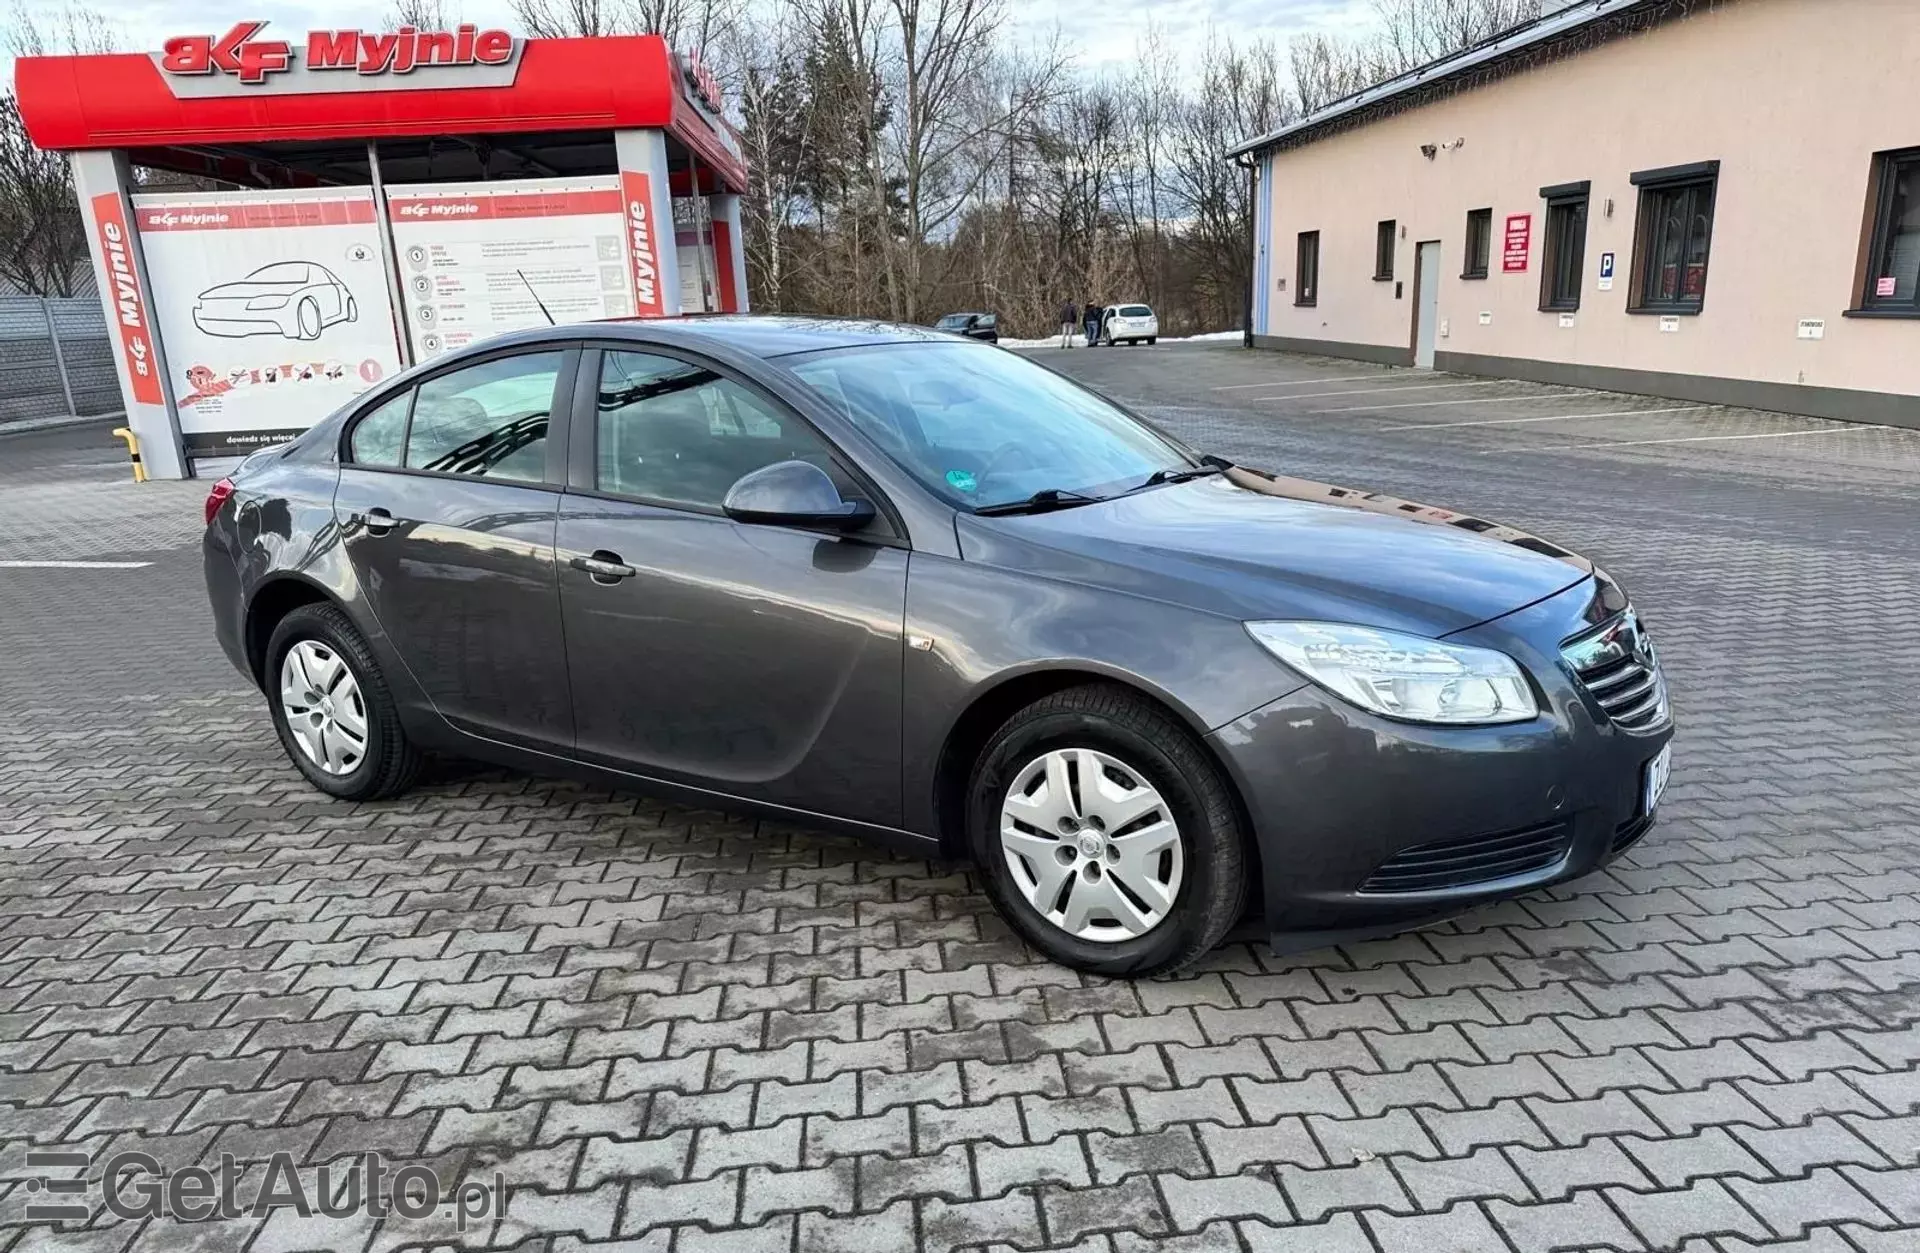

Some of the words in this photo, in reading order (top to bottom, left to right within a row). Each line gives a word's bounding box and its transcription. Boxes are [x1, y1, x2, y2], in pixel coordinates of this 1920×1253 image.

[307, 24, 513, 75] Myjnie
[180, 212, 229, 225] Myjnie
[431, 203, 479, 216] Myjnie
[629, 200, 656, 305] Myjnie
[104, 222, 141, 328] Myjnie
[1602, 255, 1612, 276] P
[226, 435, 259, 444] dowiedz
[260, 434, 271, 444] się
